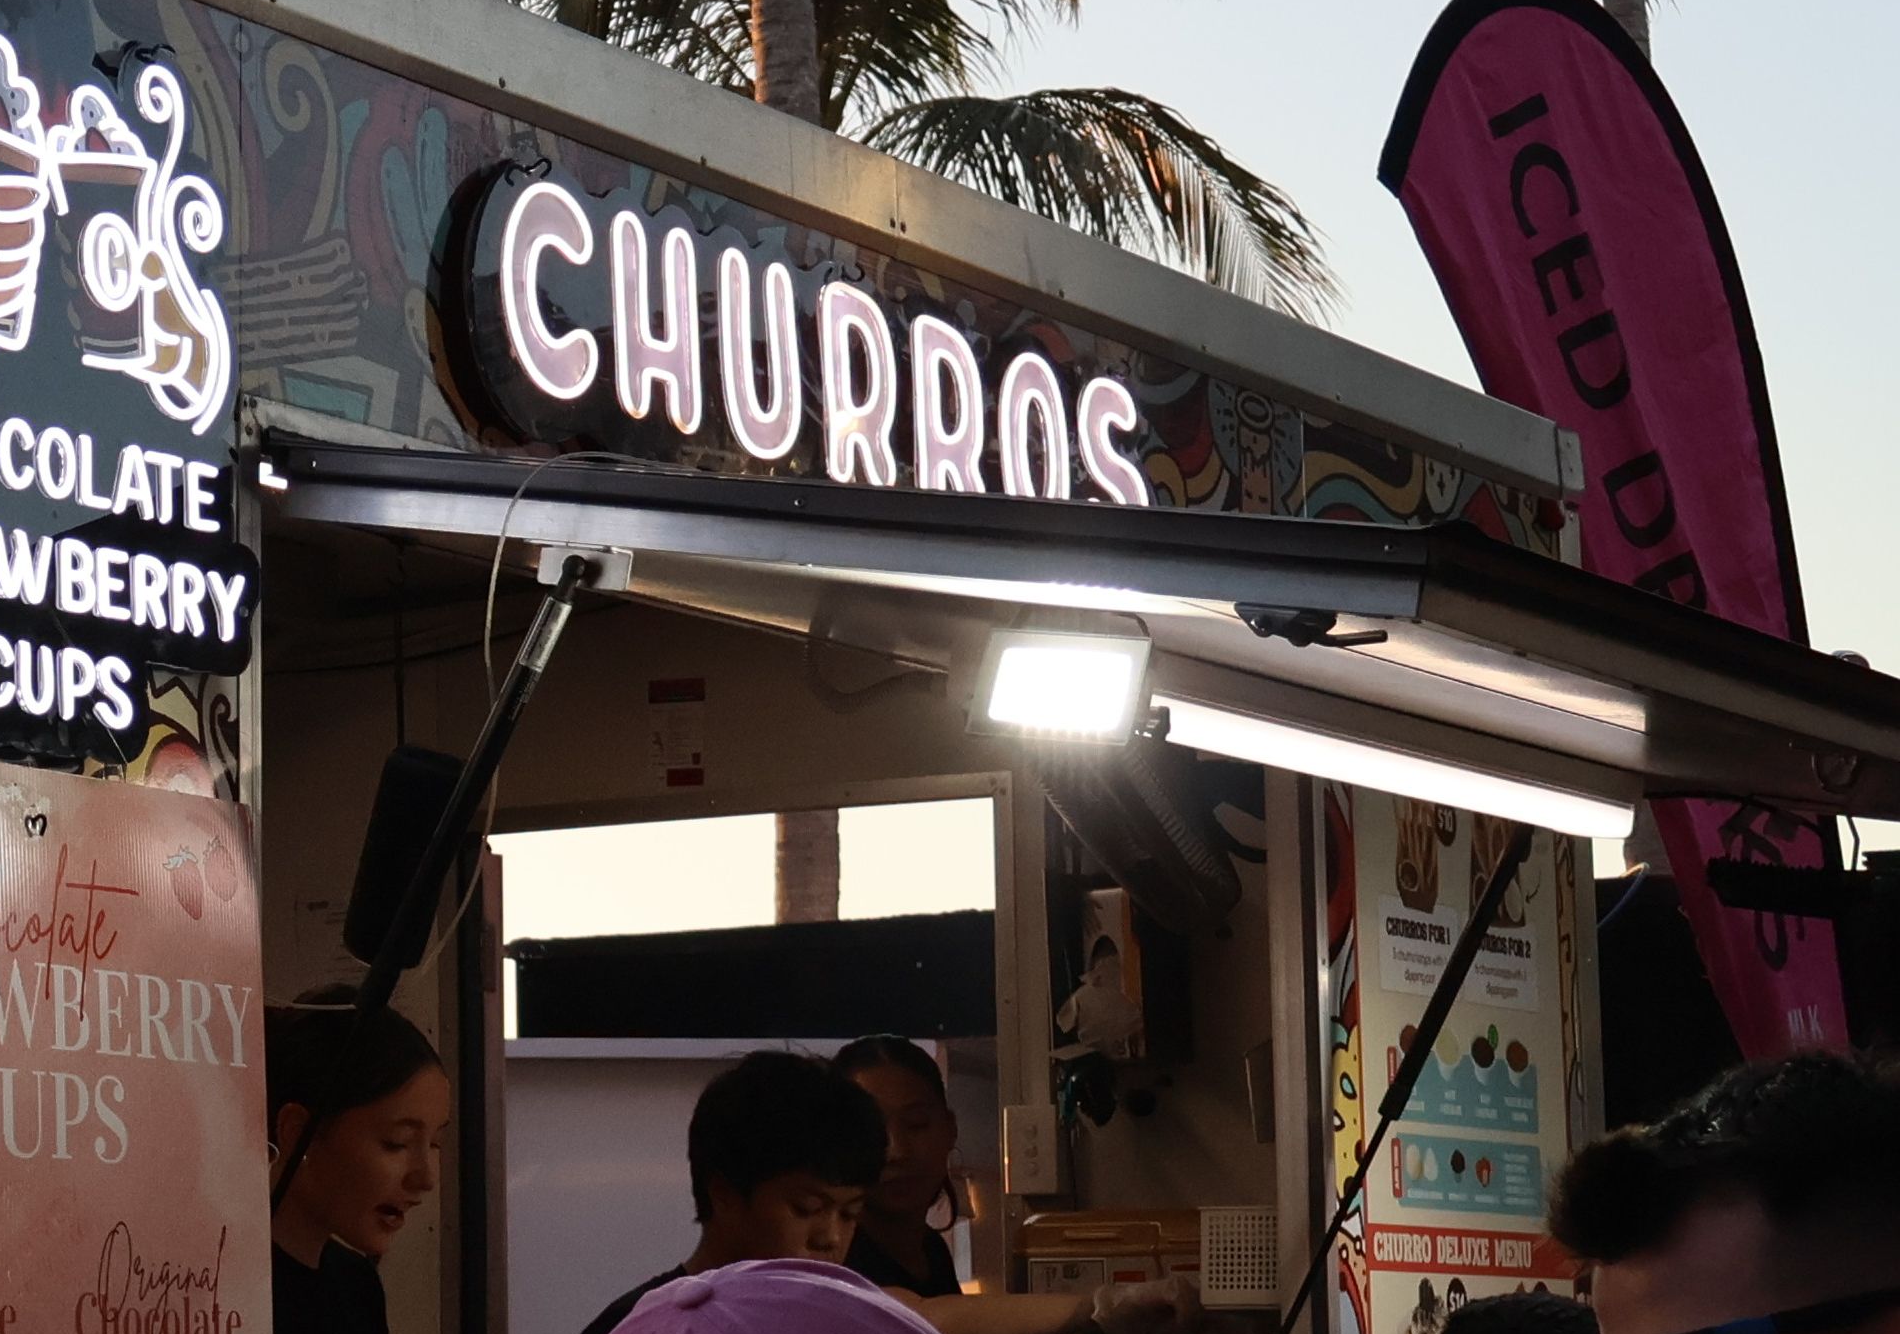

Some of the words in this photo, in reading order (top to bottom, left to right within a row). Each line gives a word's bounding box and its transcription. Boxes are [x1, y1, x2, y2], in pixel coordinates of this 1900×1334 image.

[500, 180, 1151, 507] CHURROS
[1488, 92, 1631, 410] ICED
[96, 1221, 227, 1334] Original
[1373, 1231, 1432, 1264] CHURRO
[1436, 1234, 1490, 1267] DELUXE
[1494, 1238, 1532, 1268] MENU
